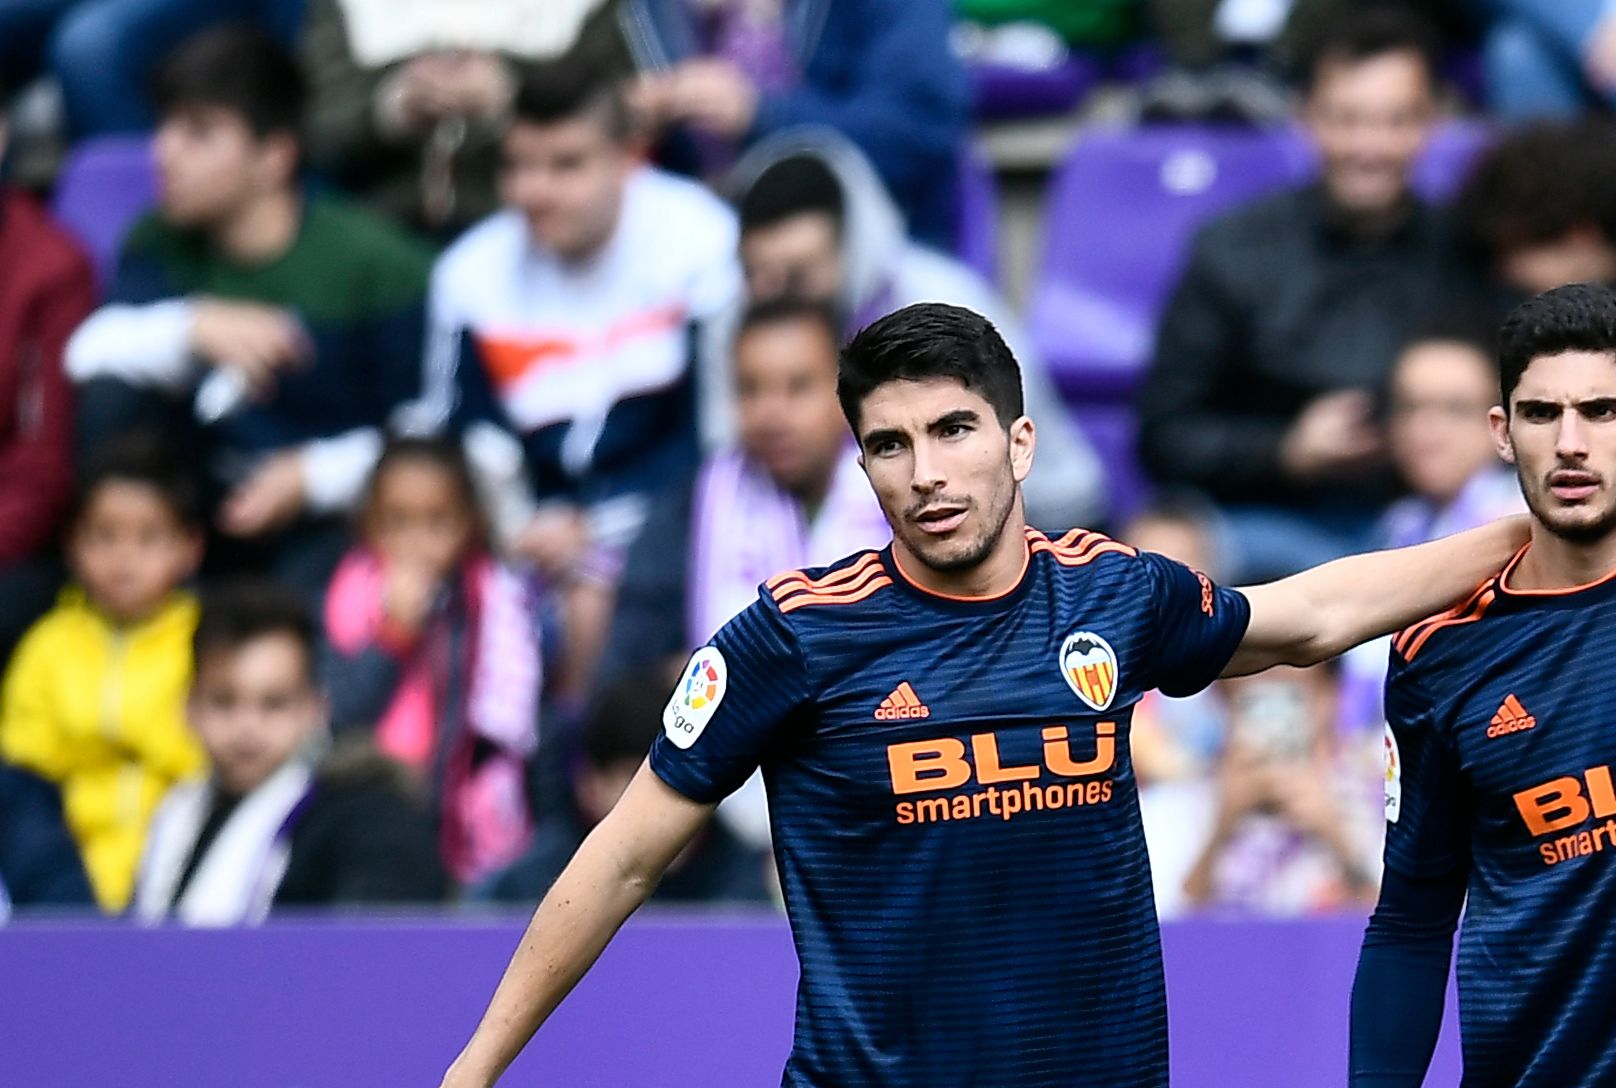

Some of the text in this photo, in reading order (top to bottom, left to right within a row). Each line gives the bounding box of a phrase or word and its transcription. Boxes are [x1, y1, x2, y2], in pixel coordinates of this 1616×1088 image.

[874, 704, 931, 720] adidas
[1487, 716, 1536, 738] adidas
[896, 779, 1113, 824] smartphones
